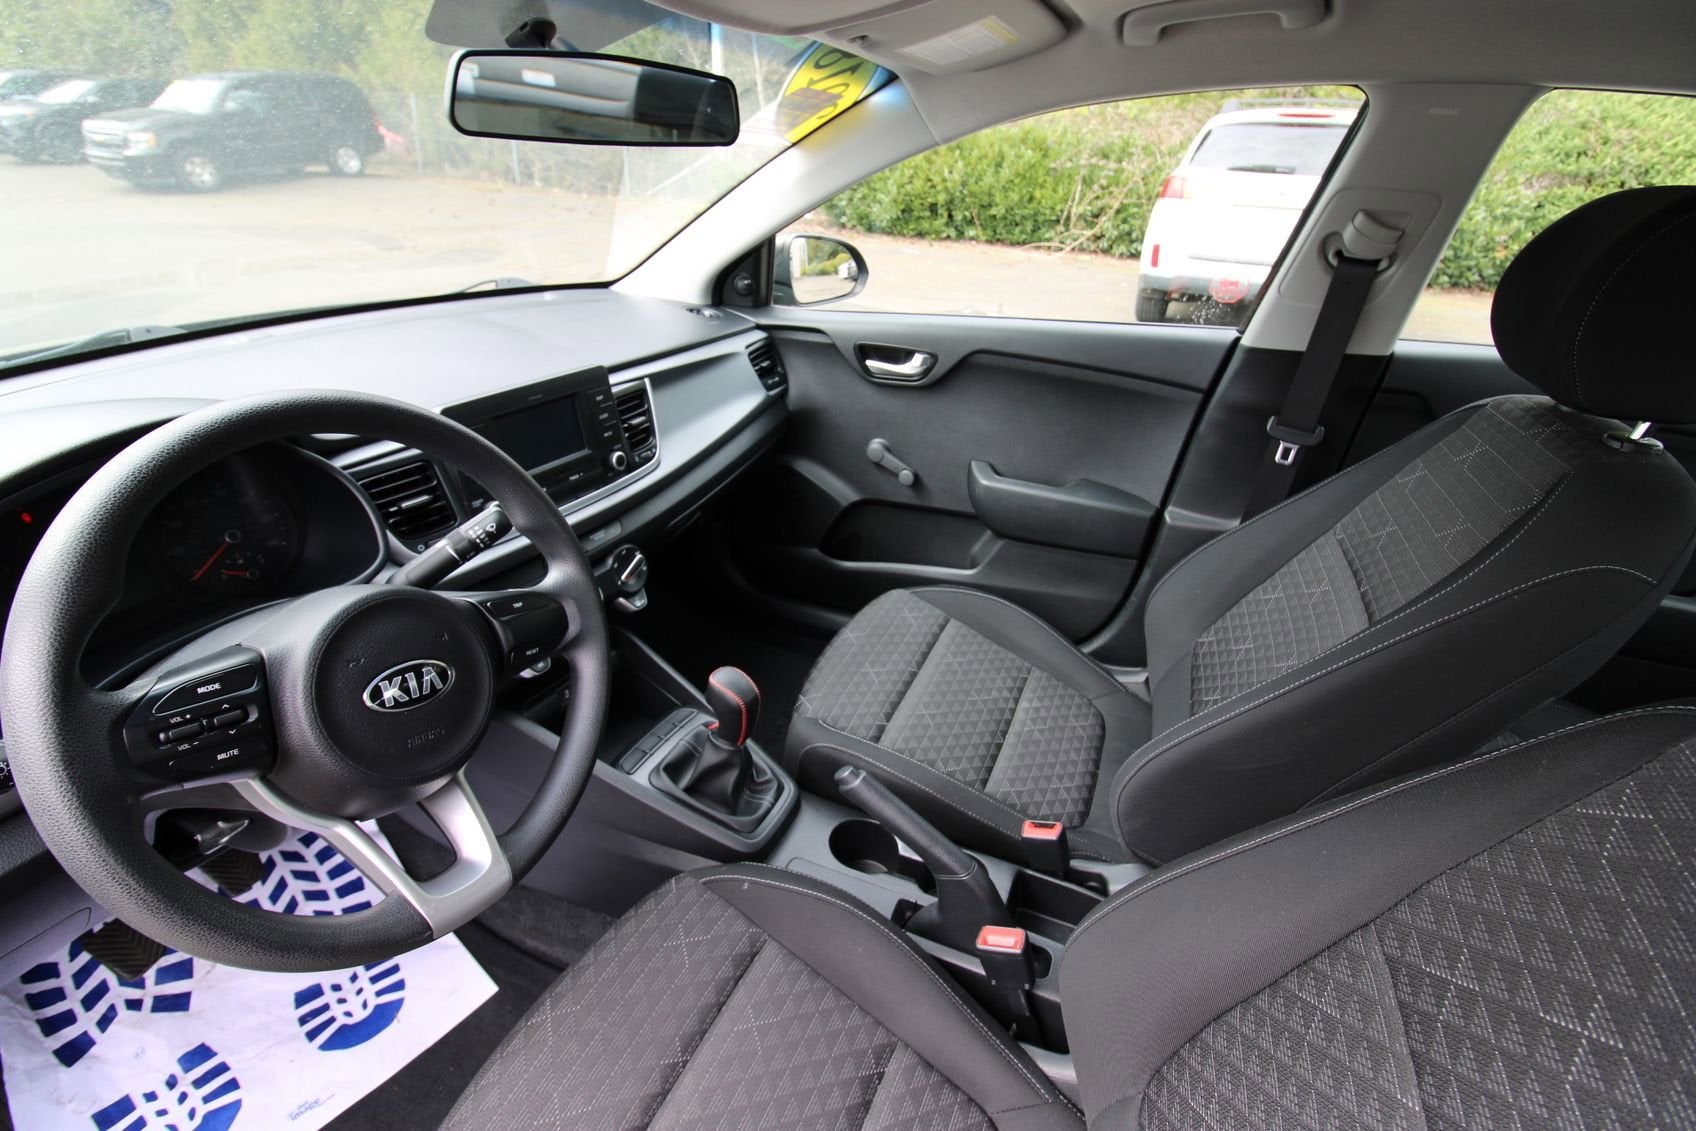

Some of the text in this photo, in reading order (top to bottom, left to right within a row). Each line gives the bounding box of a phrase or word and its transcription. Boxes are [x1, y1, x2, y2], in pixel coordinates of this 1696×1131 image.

[197, 682, 221, 694] MODE
[378, 666, 443, 708] KIA
[169, 716, 184, 724] VOL
[177, 743, 191, 751] VOL
[217, 748, 239, 760] MUTE
